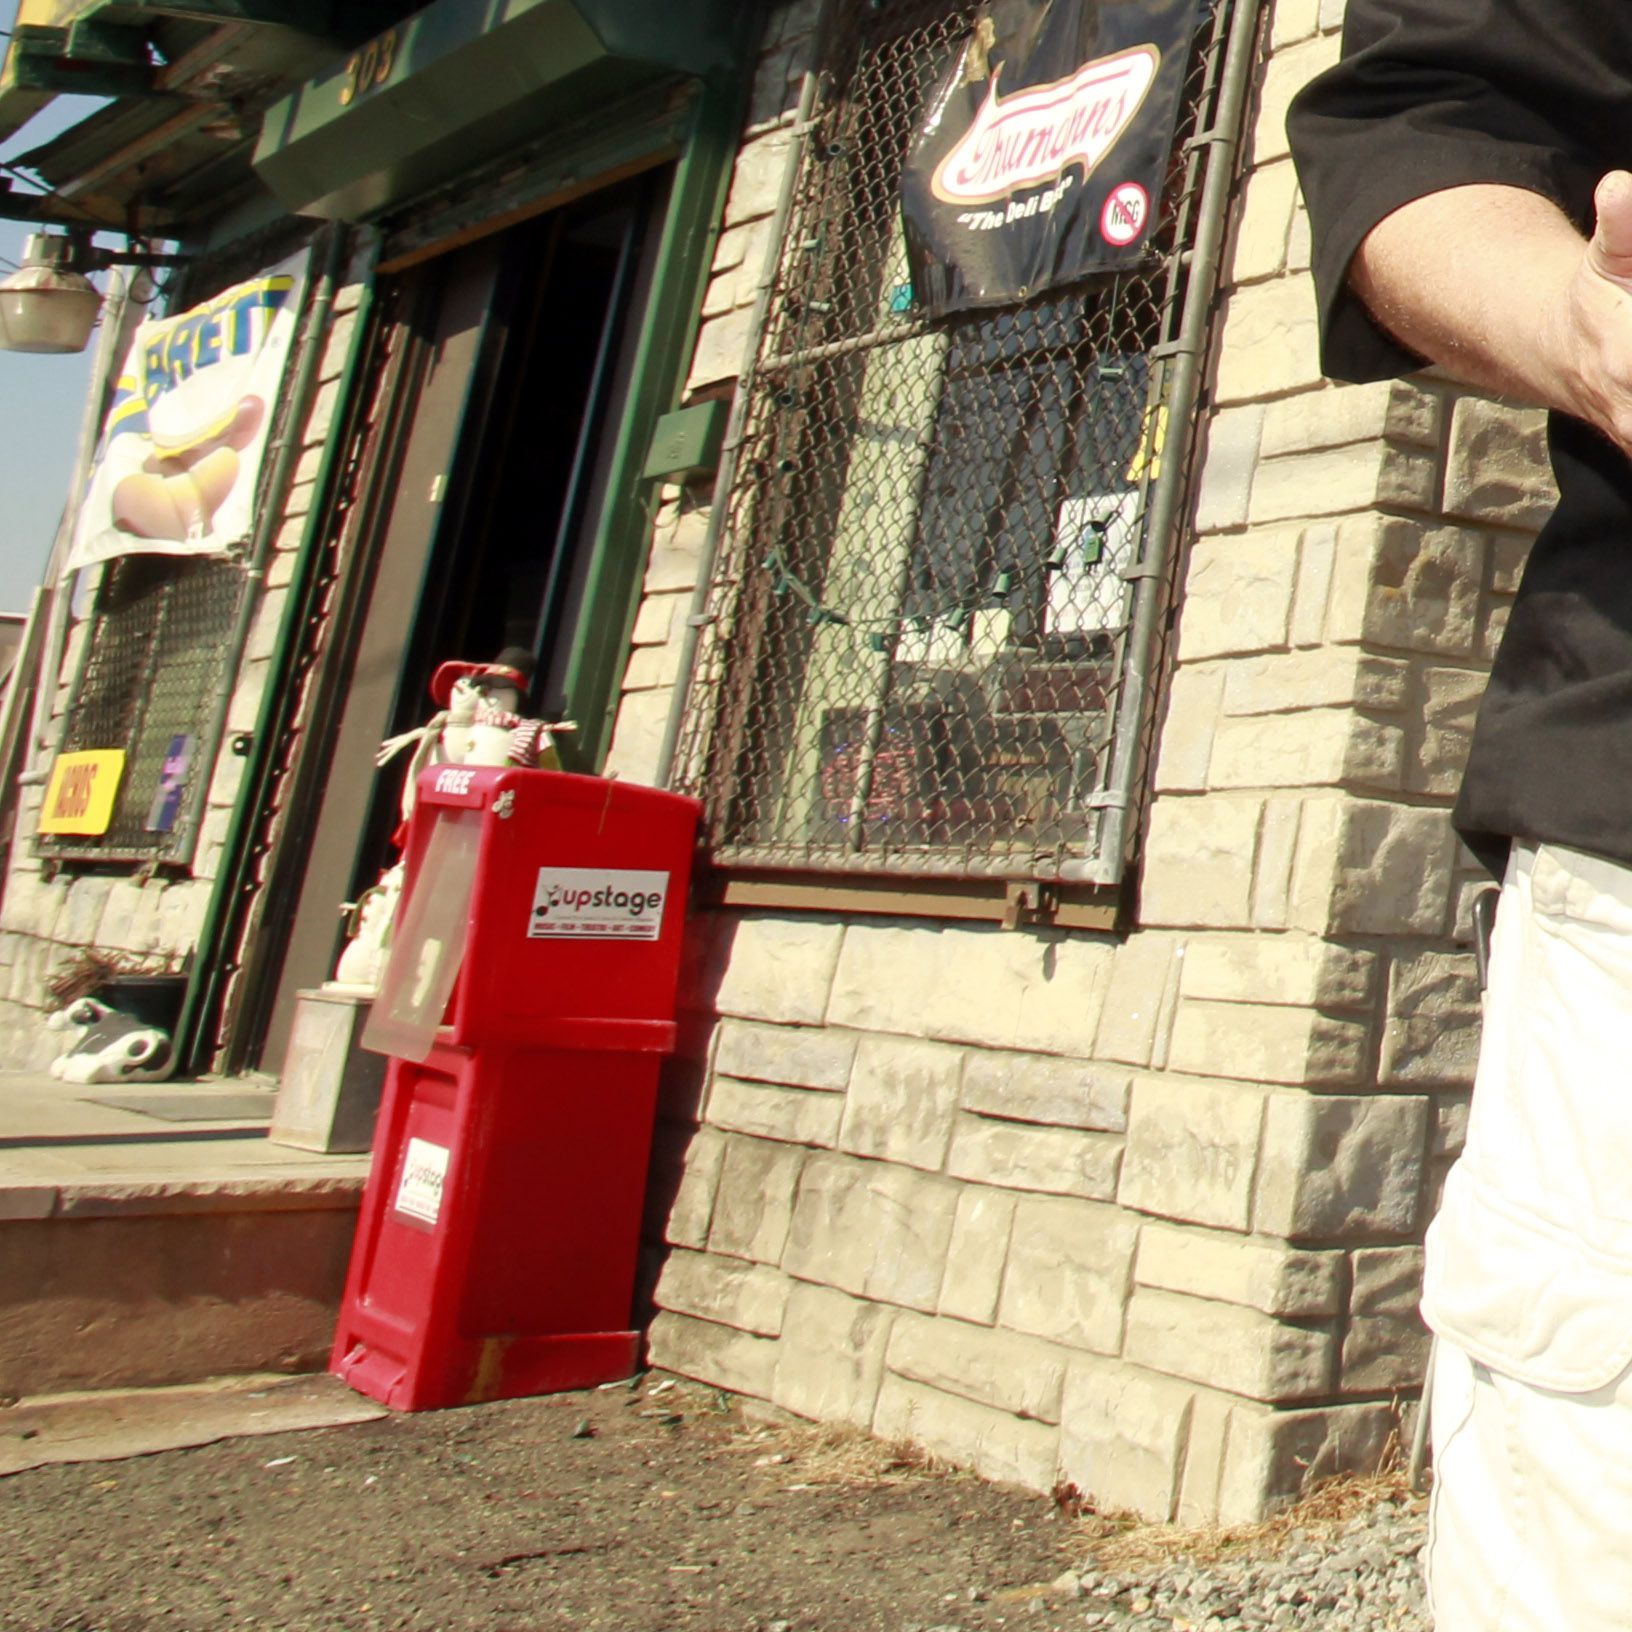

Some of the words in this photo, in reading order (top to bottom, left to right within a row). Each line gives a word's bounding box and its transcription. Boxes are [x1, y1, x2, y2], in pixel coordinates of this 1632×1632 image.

[1005, 196, 1039, 225] Deli
[434, 767, 477, 796] FREE
[562, 884, 662, 916] upstage
